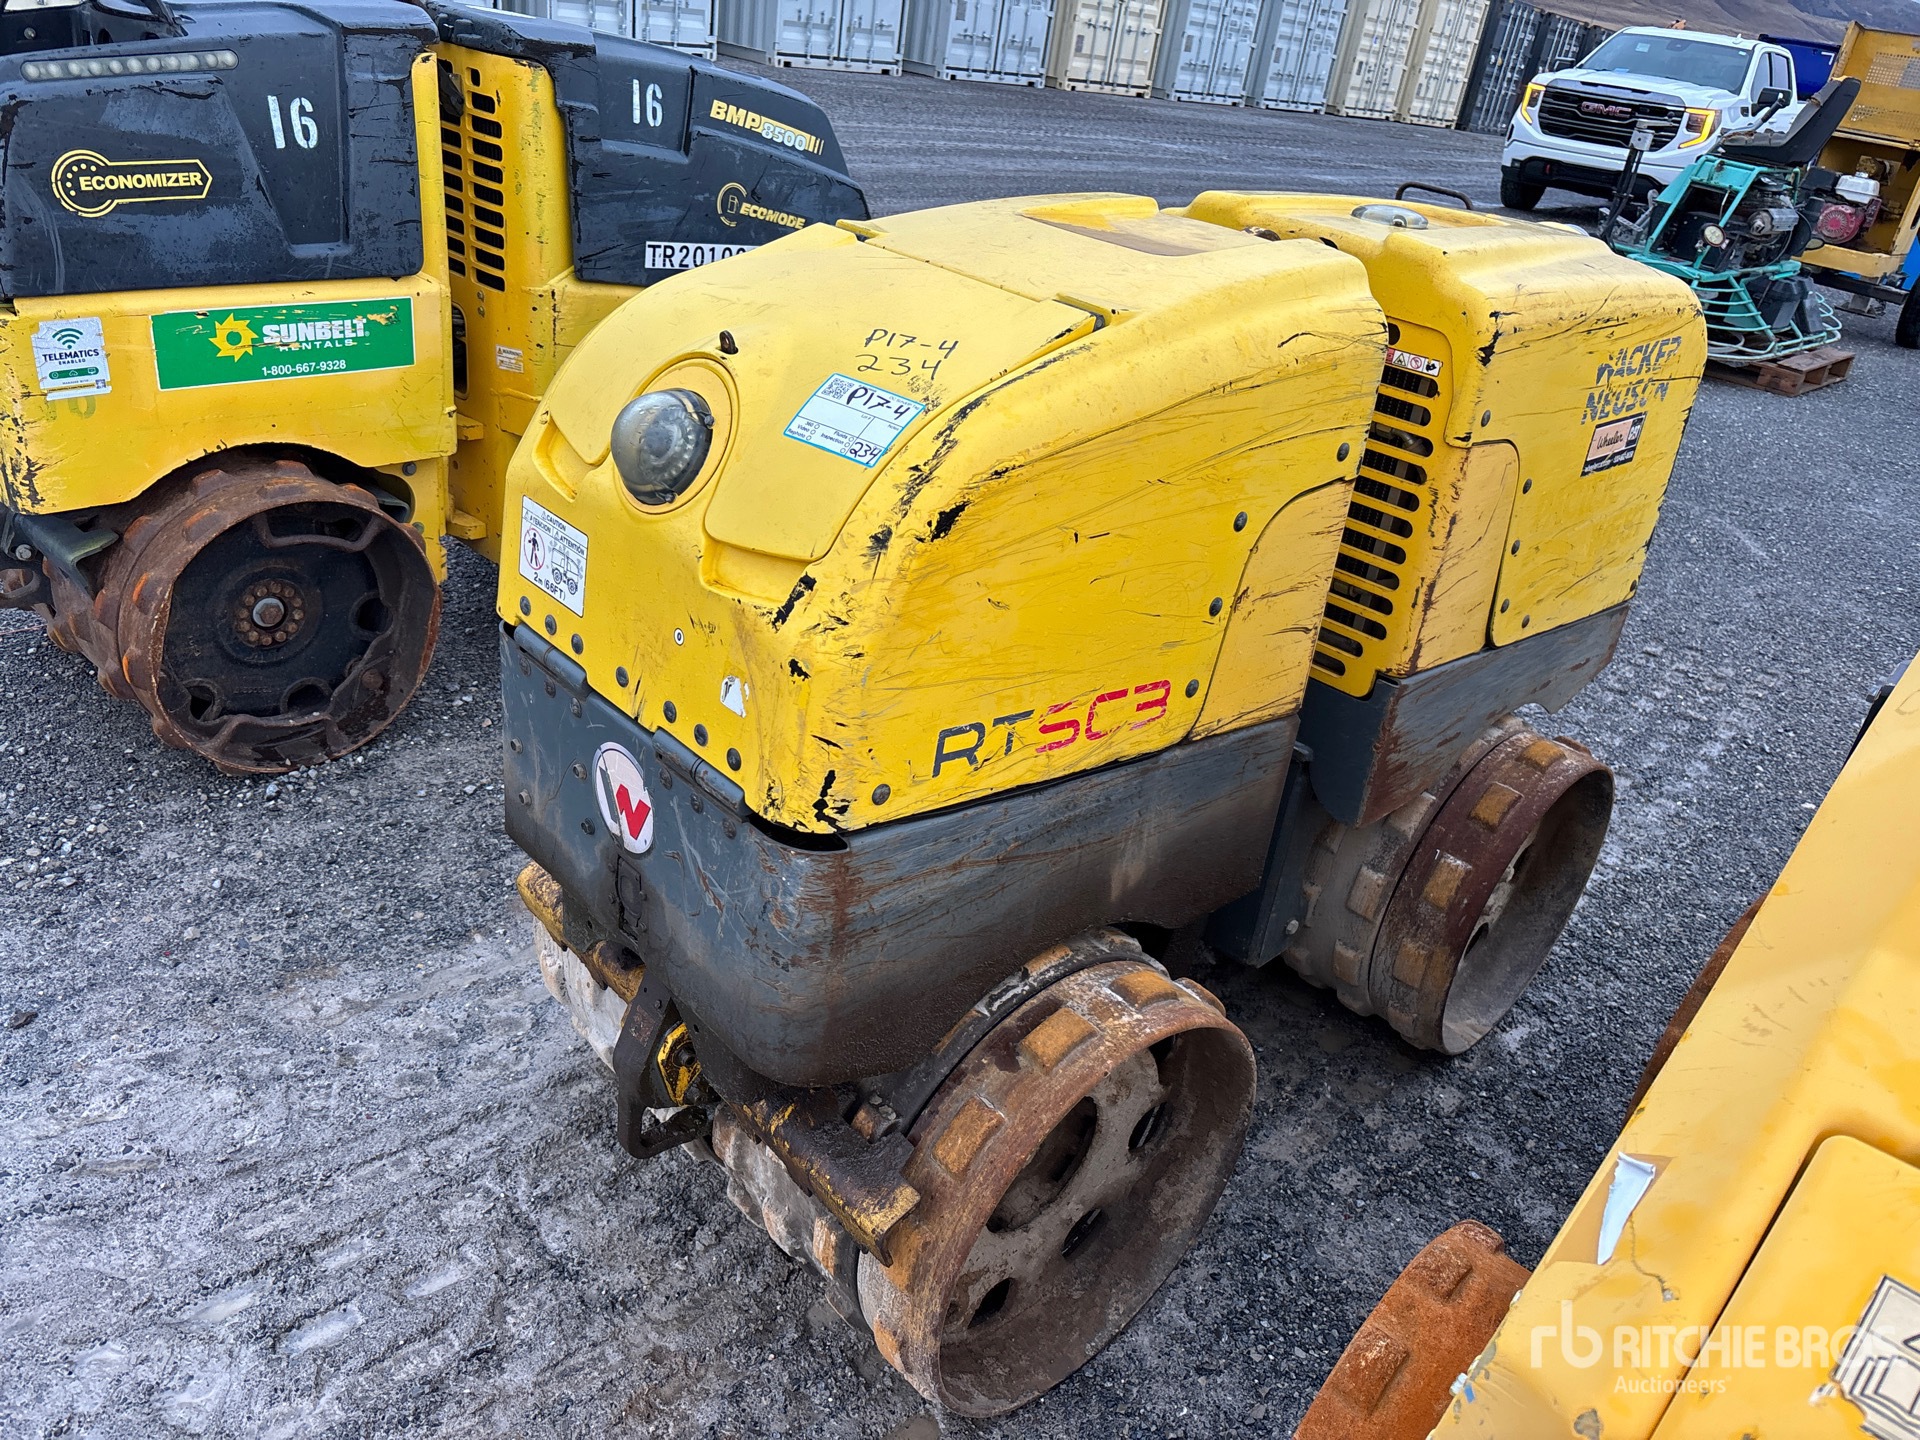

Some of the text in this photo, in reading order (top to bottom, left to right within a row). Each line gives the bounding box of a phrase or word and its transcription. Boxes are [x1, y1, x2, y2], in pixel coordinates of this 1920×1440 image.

[633, 79, 662, 127] 16
[1581, 101, 1632, 118] GMC
[267, 95, 318, 149] 16
[79, 172, 203, 191] ECONOMIZER
[740, 202, 806, 230] ECOMODE
[262, 318, 367, 343] SUNBELT
[864, 329, 959, 359] P17-4
[42, 349, 99, 362] TELEMATICS
[262, 359, 346, 376] 1-800-667-9328
[855, 354, 942, 380] 234
[846, 386, 911, 420] P17-4
[797, 424, 810, 433] Video
[821, 433, 844, 445] Inspection
[834, 430, 848, 440] Fluids
[849, 441, 882, 464] 234
[546, 514, 566, 532] CAUTION
